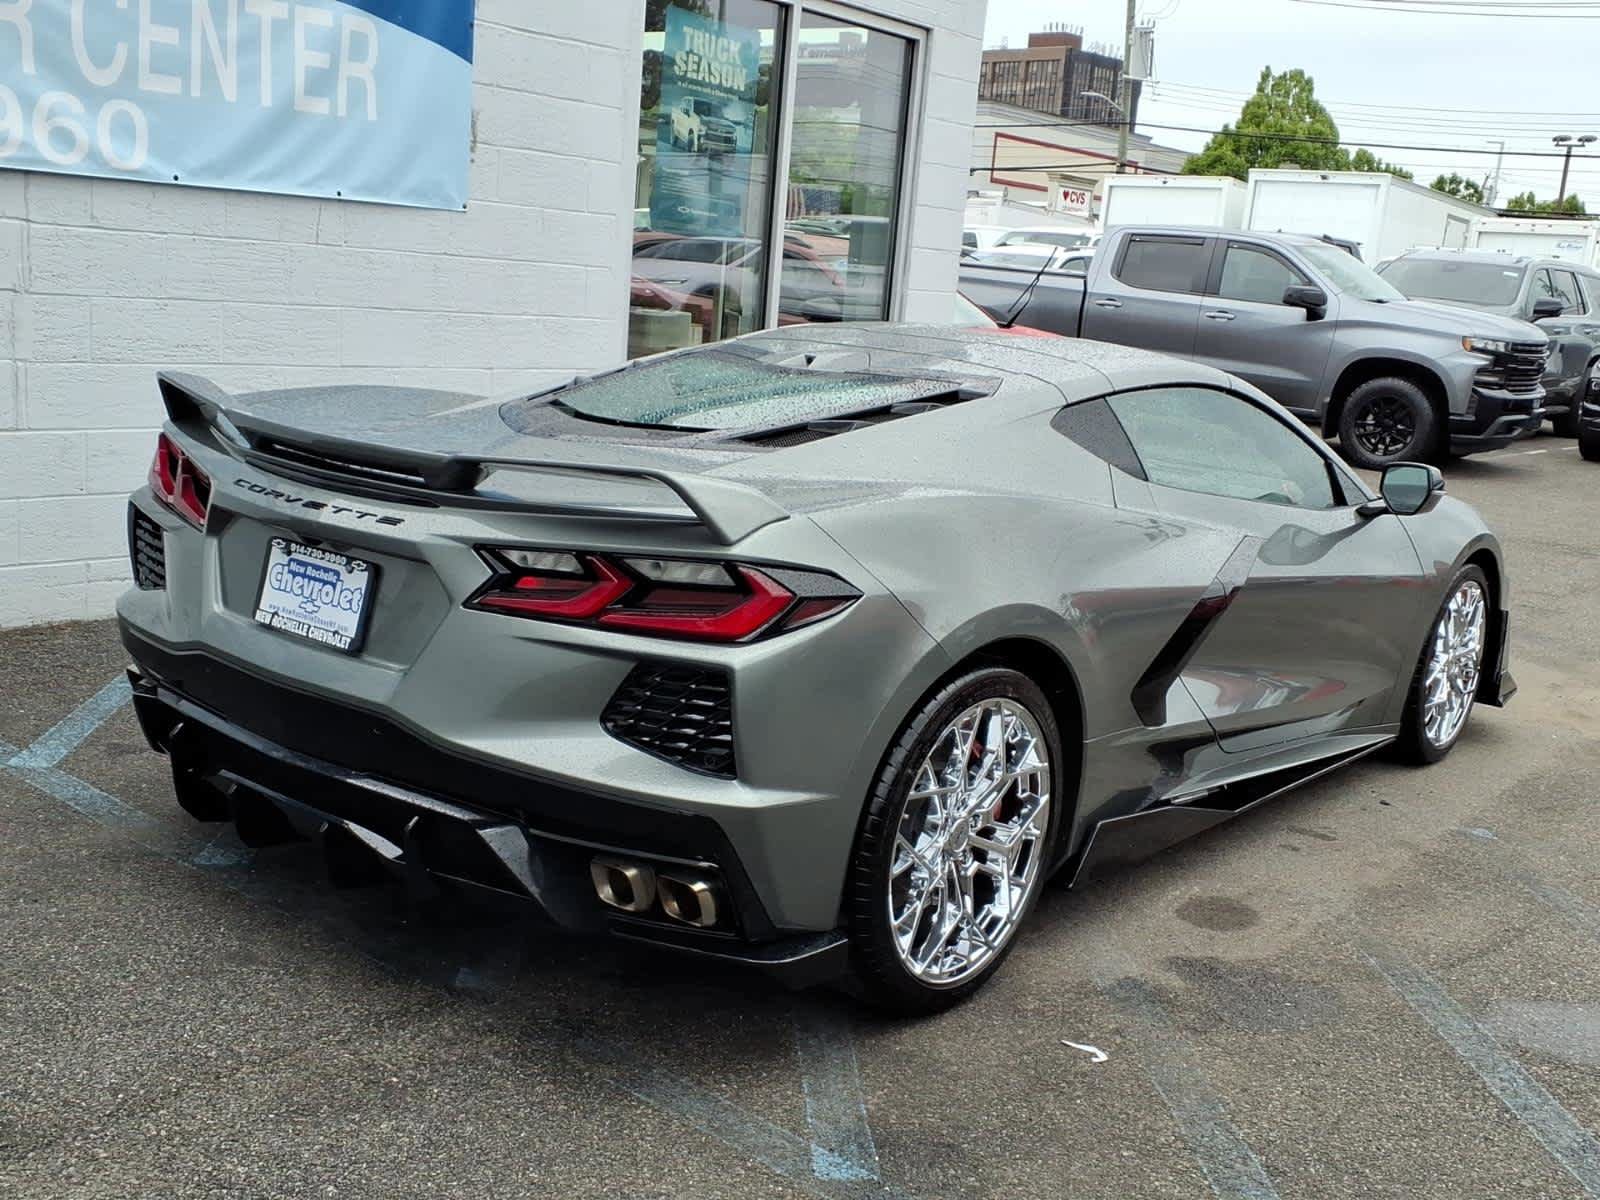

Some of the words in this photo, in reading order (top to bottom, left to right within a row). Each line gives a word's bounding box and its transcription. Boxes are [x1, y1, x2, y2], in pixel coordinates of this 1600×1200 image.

[70, 0, 379, 121] CENTER
[682, 25, 742, 65] TRUCK
[673, 50, 748, 92] SEASON
[1070, 190, 1086, 205] CVS
[233, 478, 405, 527] CORVETTE
[269, 562, 364, 614] Chevrolet
[290, 561, 306, 576] New
[306, 565, 338, 584] Rochelle
[255, 609, 273, 625] NEW
[271, 613, 310, 637] ROCHELLE
[308, 626, 352, 650] CHEVROLET
